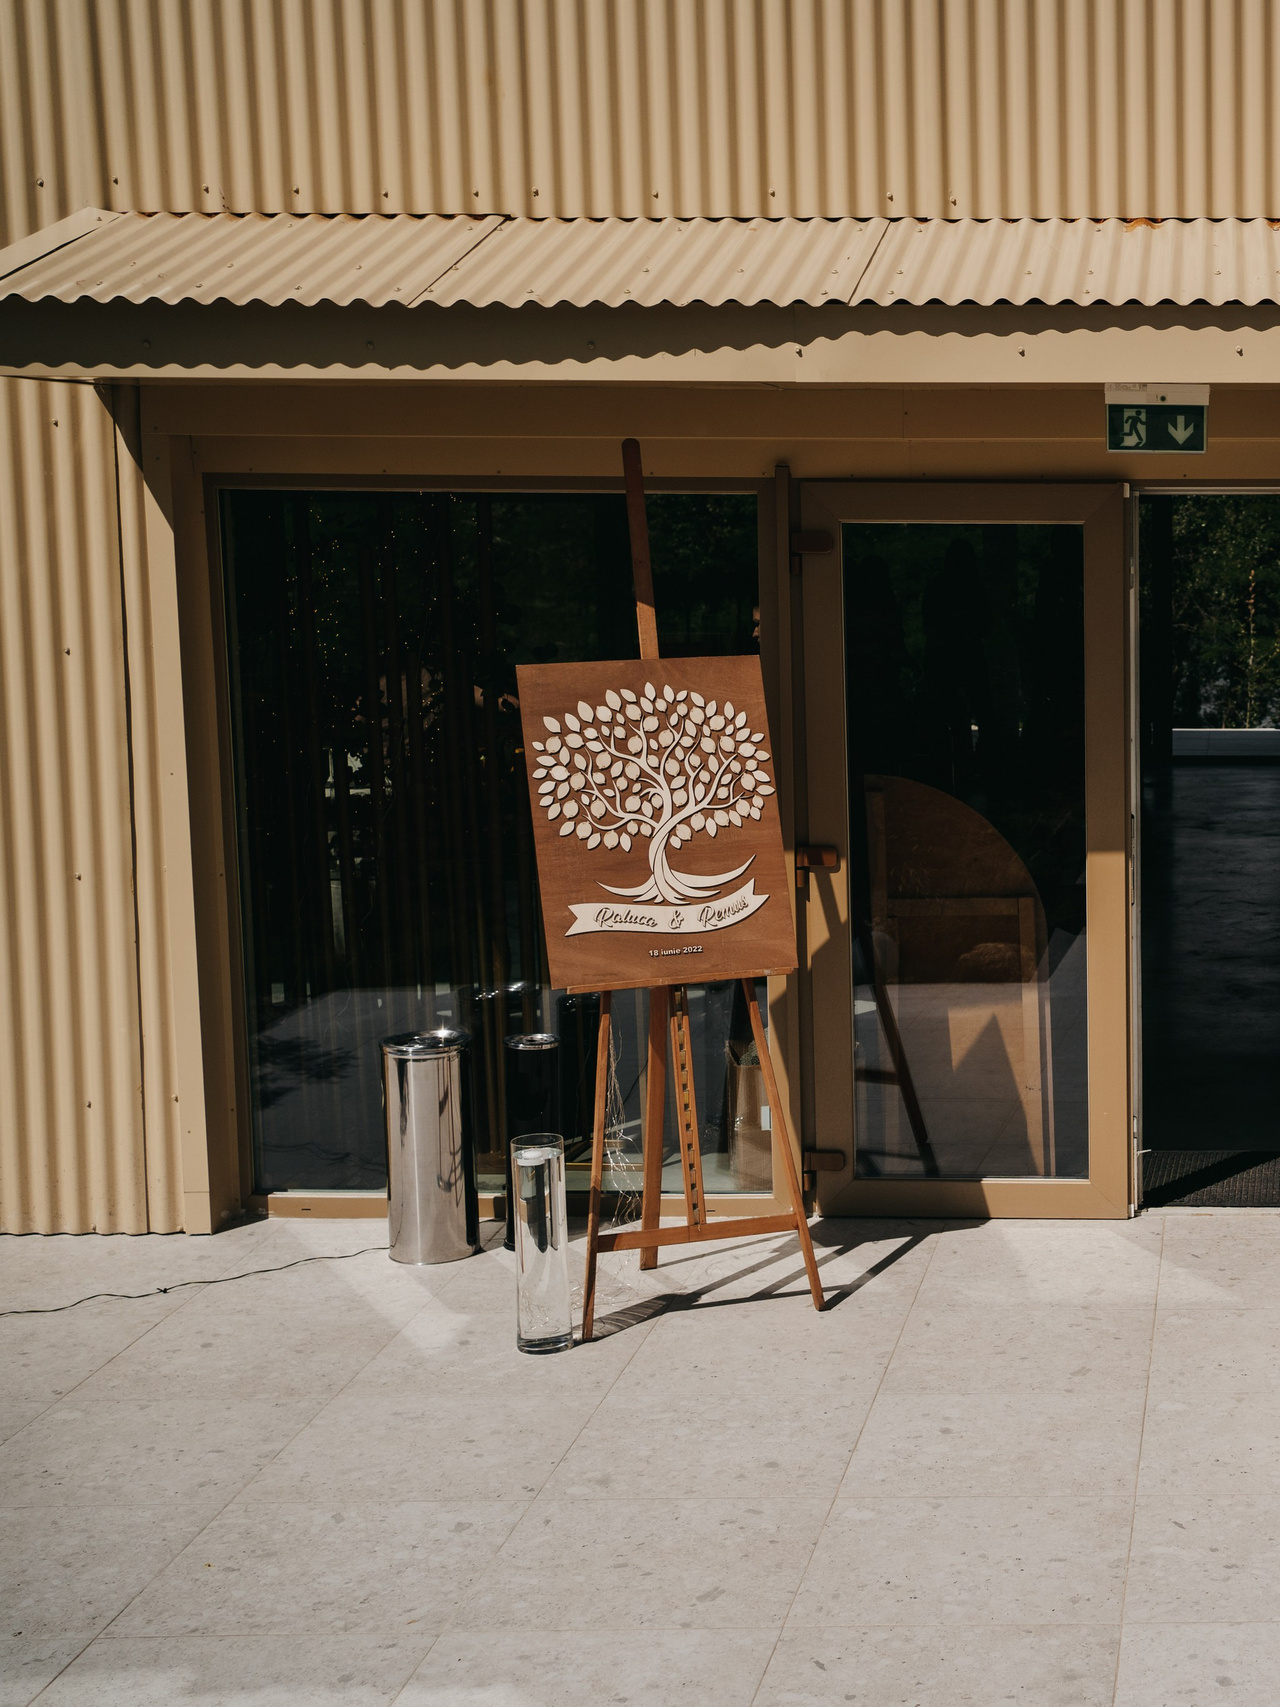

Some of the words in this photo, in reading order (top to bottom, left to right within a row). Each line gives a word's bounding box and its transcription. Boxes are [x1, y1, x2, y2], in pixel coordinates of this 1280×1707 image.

[594, 907, 659, 929] Raluca
[668, 909, 685, 930] &
[697, 895, 750, 929] Remus
[648, 948, 660, 958] 18
[660, 947, 682, 957] iunie
[682, 944, 704, 955] 2022
